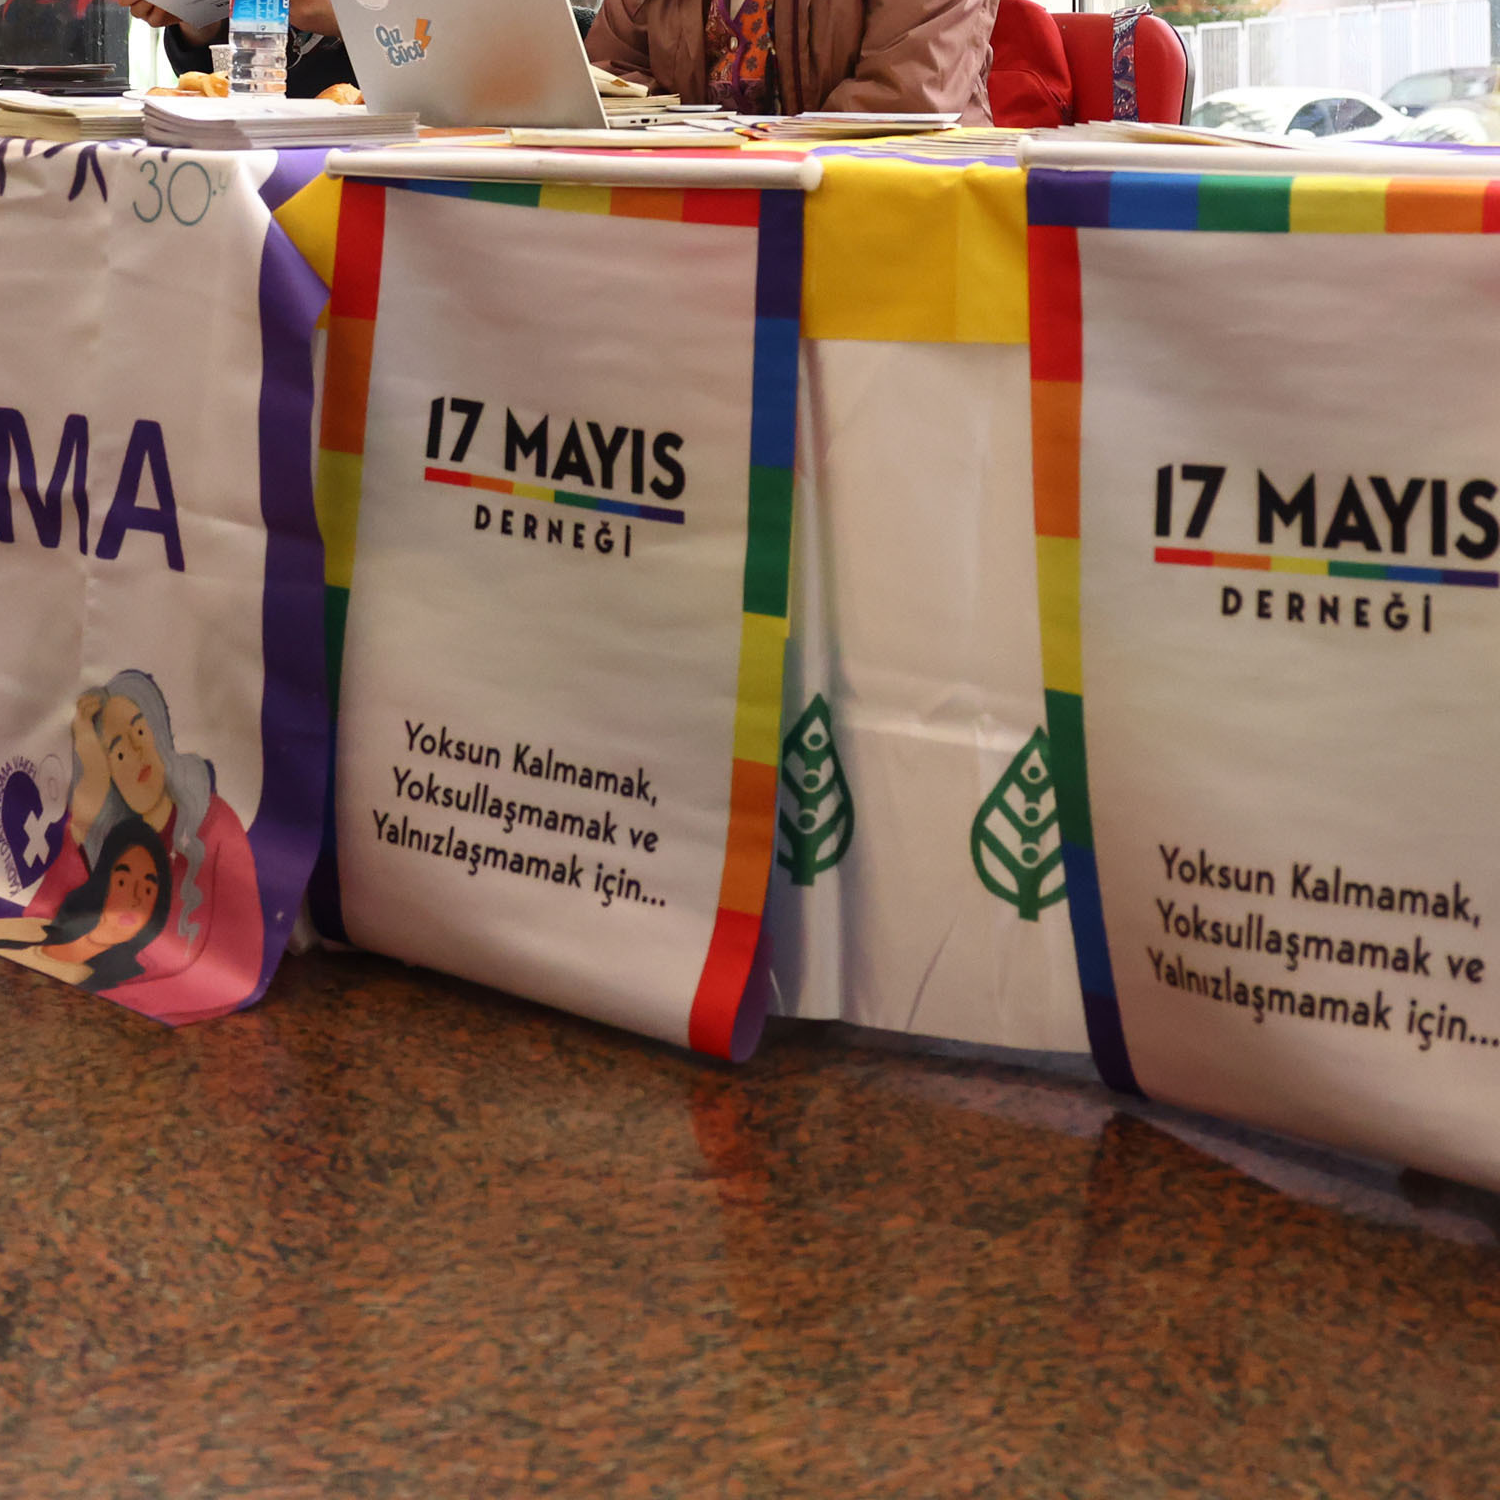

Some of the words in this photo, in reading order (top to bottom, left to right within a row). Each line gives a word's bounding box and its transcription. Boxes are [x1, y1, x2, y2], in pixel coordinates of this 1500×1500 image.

[426, 396, 485, 463] 17
[504, 406, 686, 501] MAYIS
[474, 504, 633, 558] DERNEĞİ
[1153, 463, 1227, 538] 17
[1257, 468, 1500, 561] MAYIS
[1221, 587, 1433, 633] DERNEĞİ
[404, 720, 501, 771] Yoksun
[513, 743, 658, 808] Kalmamak,
[393, 766, 618, 847] Yoksullaşmamak
[628, 828, 659, 854] ve
[373, 811, 583, 889] Yalnızlaşmamak
[594, 863, 666, 907] için...
[1158, 843, 1275, 897] Yoksun
[1292, 862, 1482, 927] Kalmamak,
[1156, 899, 1431, 978] Yoksullaşmamak
[1447, 952, 1485, 984] ve
[1146, 947, 1391, 1032] Yalnızlaşmamak
[1407, 999, 1500, 1051] için...
